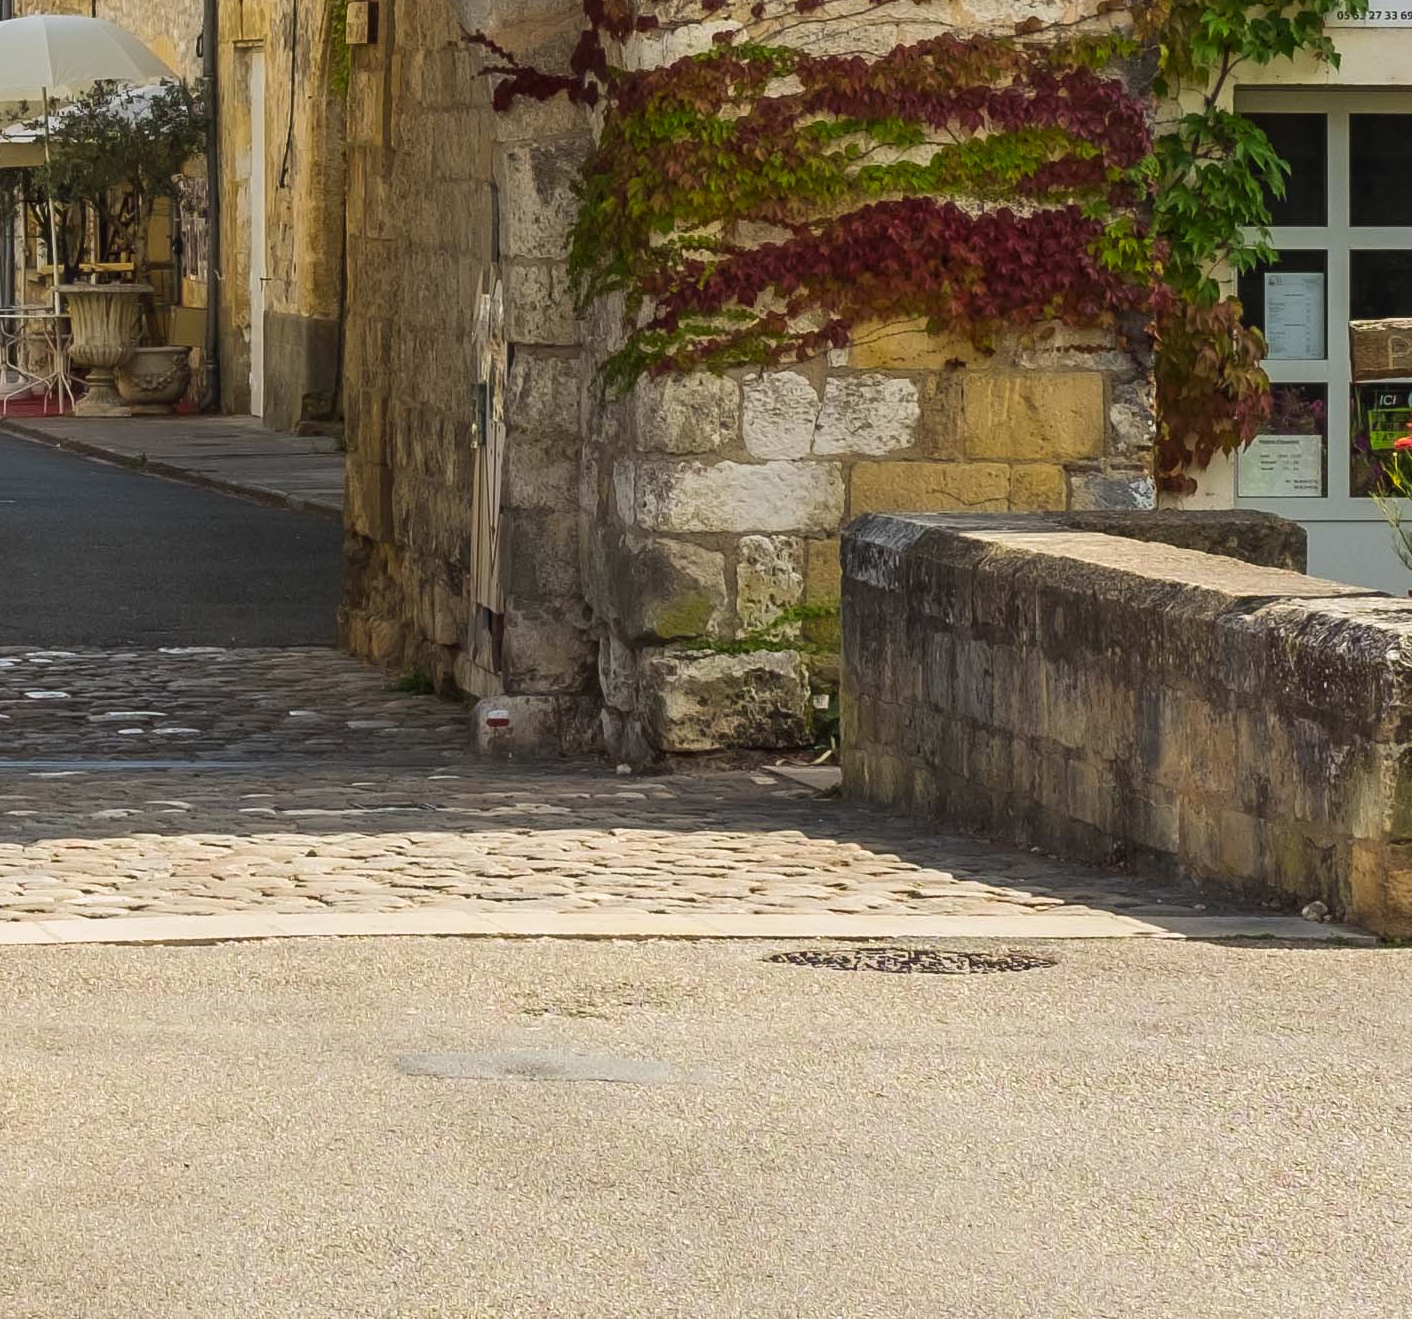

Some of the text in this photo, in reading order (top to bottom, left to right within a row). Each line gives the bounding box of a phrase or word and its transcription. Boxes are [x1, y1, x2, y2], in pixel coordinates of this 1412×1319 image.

[1337, 11, 1350, 20] 05
[1369, 11, 1382, 20] 27
[1385, 11, 1398, 20] 33
[1379, 394, 1397, 406] ICI
